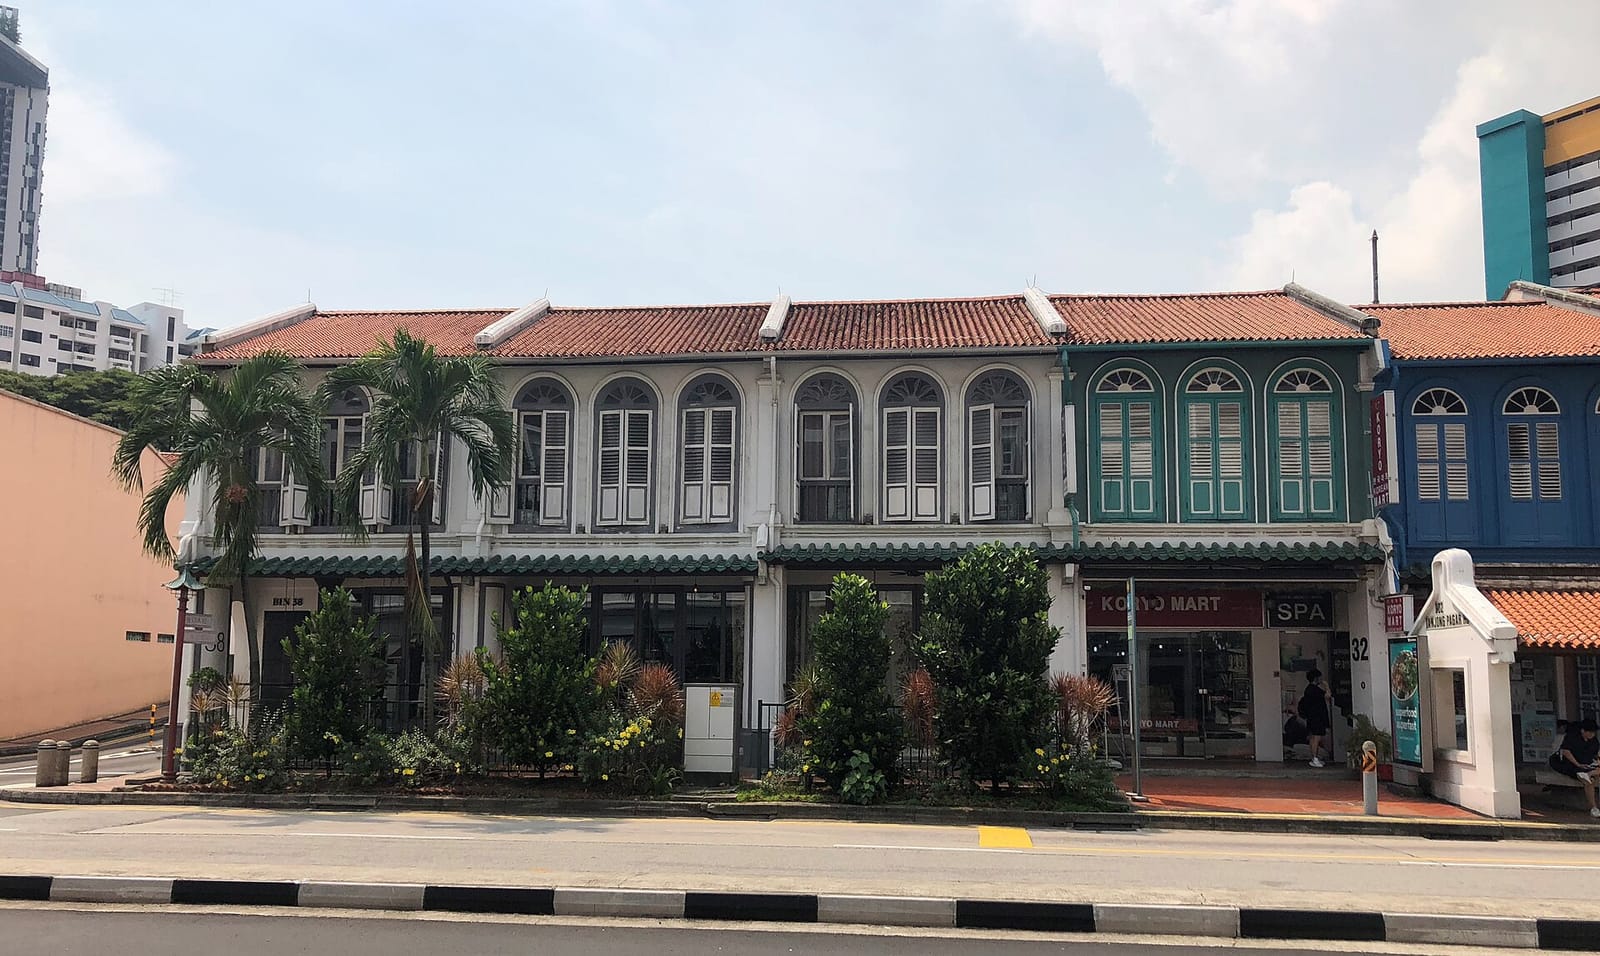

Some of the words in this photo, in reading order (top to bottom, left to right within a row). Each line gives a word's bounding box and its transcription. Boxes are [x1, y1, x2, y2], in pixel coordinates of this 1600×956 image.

[273, 597, 290, 606] BIN
[1171, 595, 1221, 611] MART
[1278, 602, 1325, 620] SPA
[1387, 615, 1402, 627] MART
[1351, 637, 1369, 661] 32
[1155, 720, 1179, 728] MART
